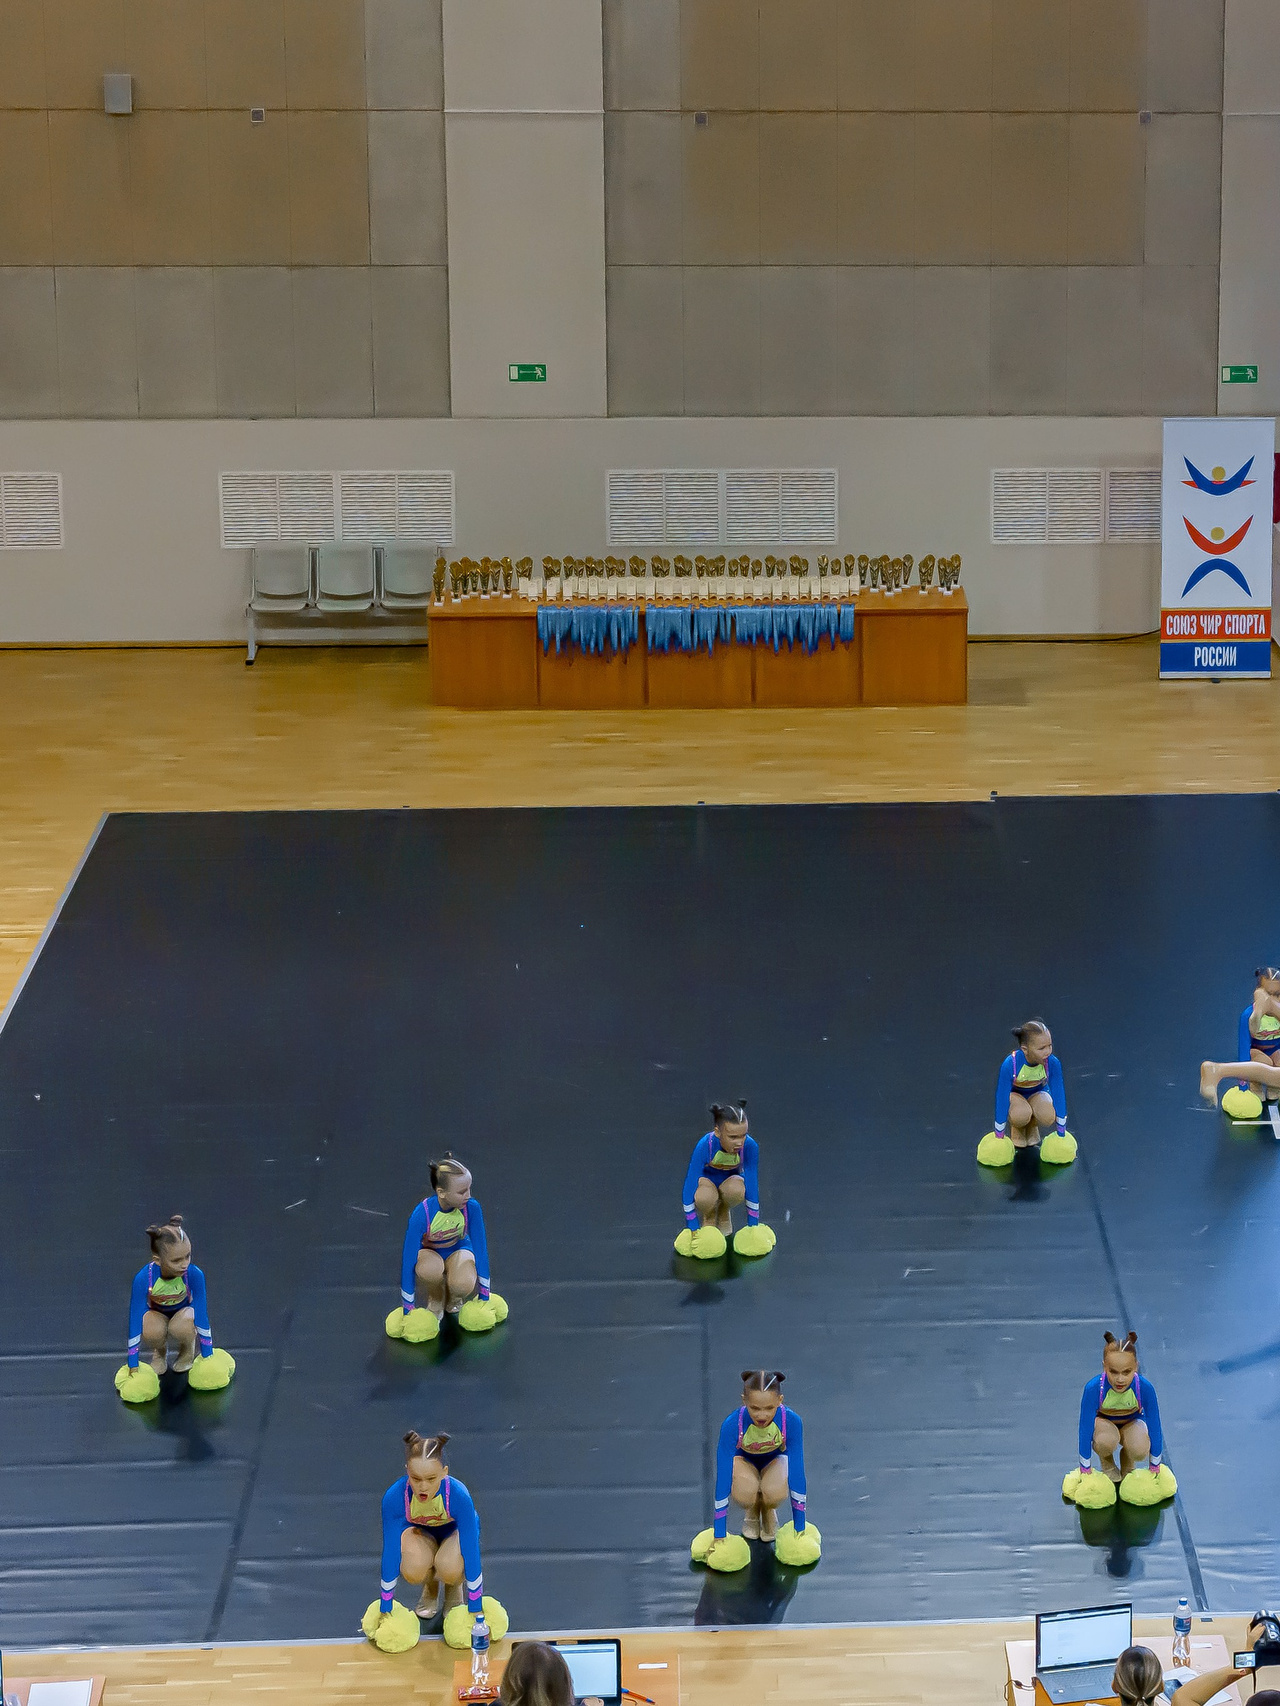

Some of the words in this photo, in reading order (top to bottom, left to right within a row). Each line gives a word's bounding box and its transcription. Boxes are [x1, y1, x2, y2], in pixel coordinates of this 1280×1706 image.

[1166, 615, 1197, 635] СОЮЗ
[1200, 615, 1222, 635] ЧИР
[1224, 614, 1266, 635] СПОРТА
[1194, 646, 1237, 667] РОССИИ
